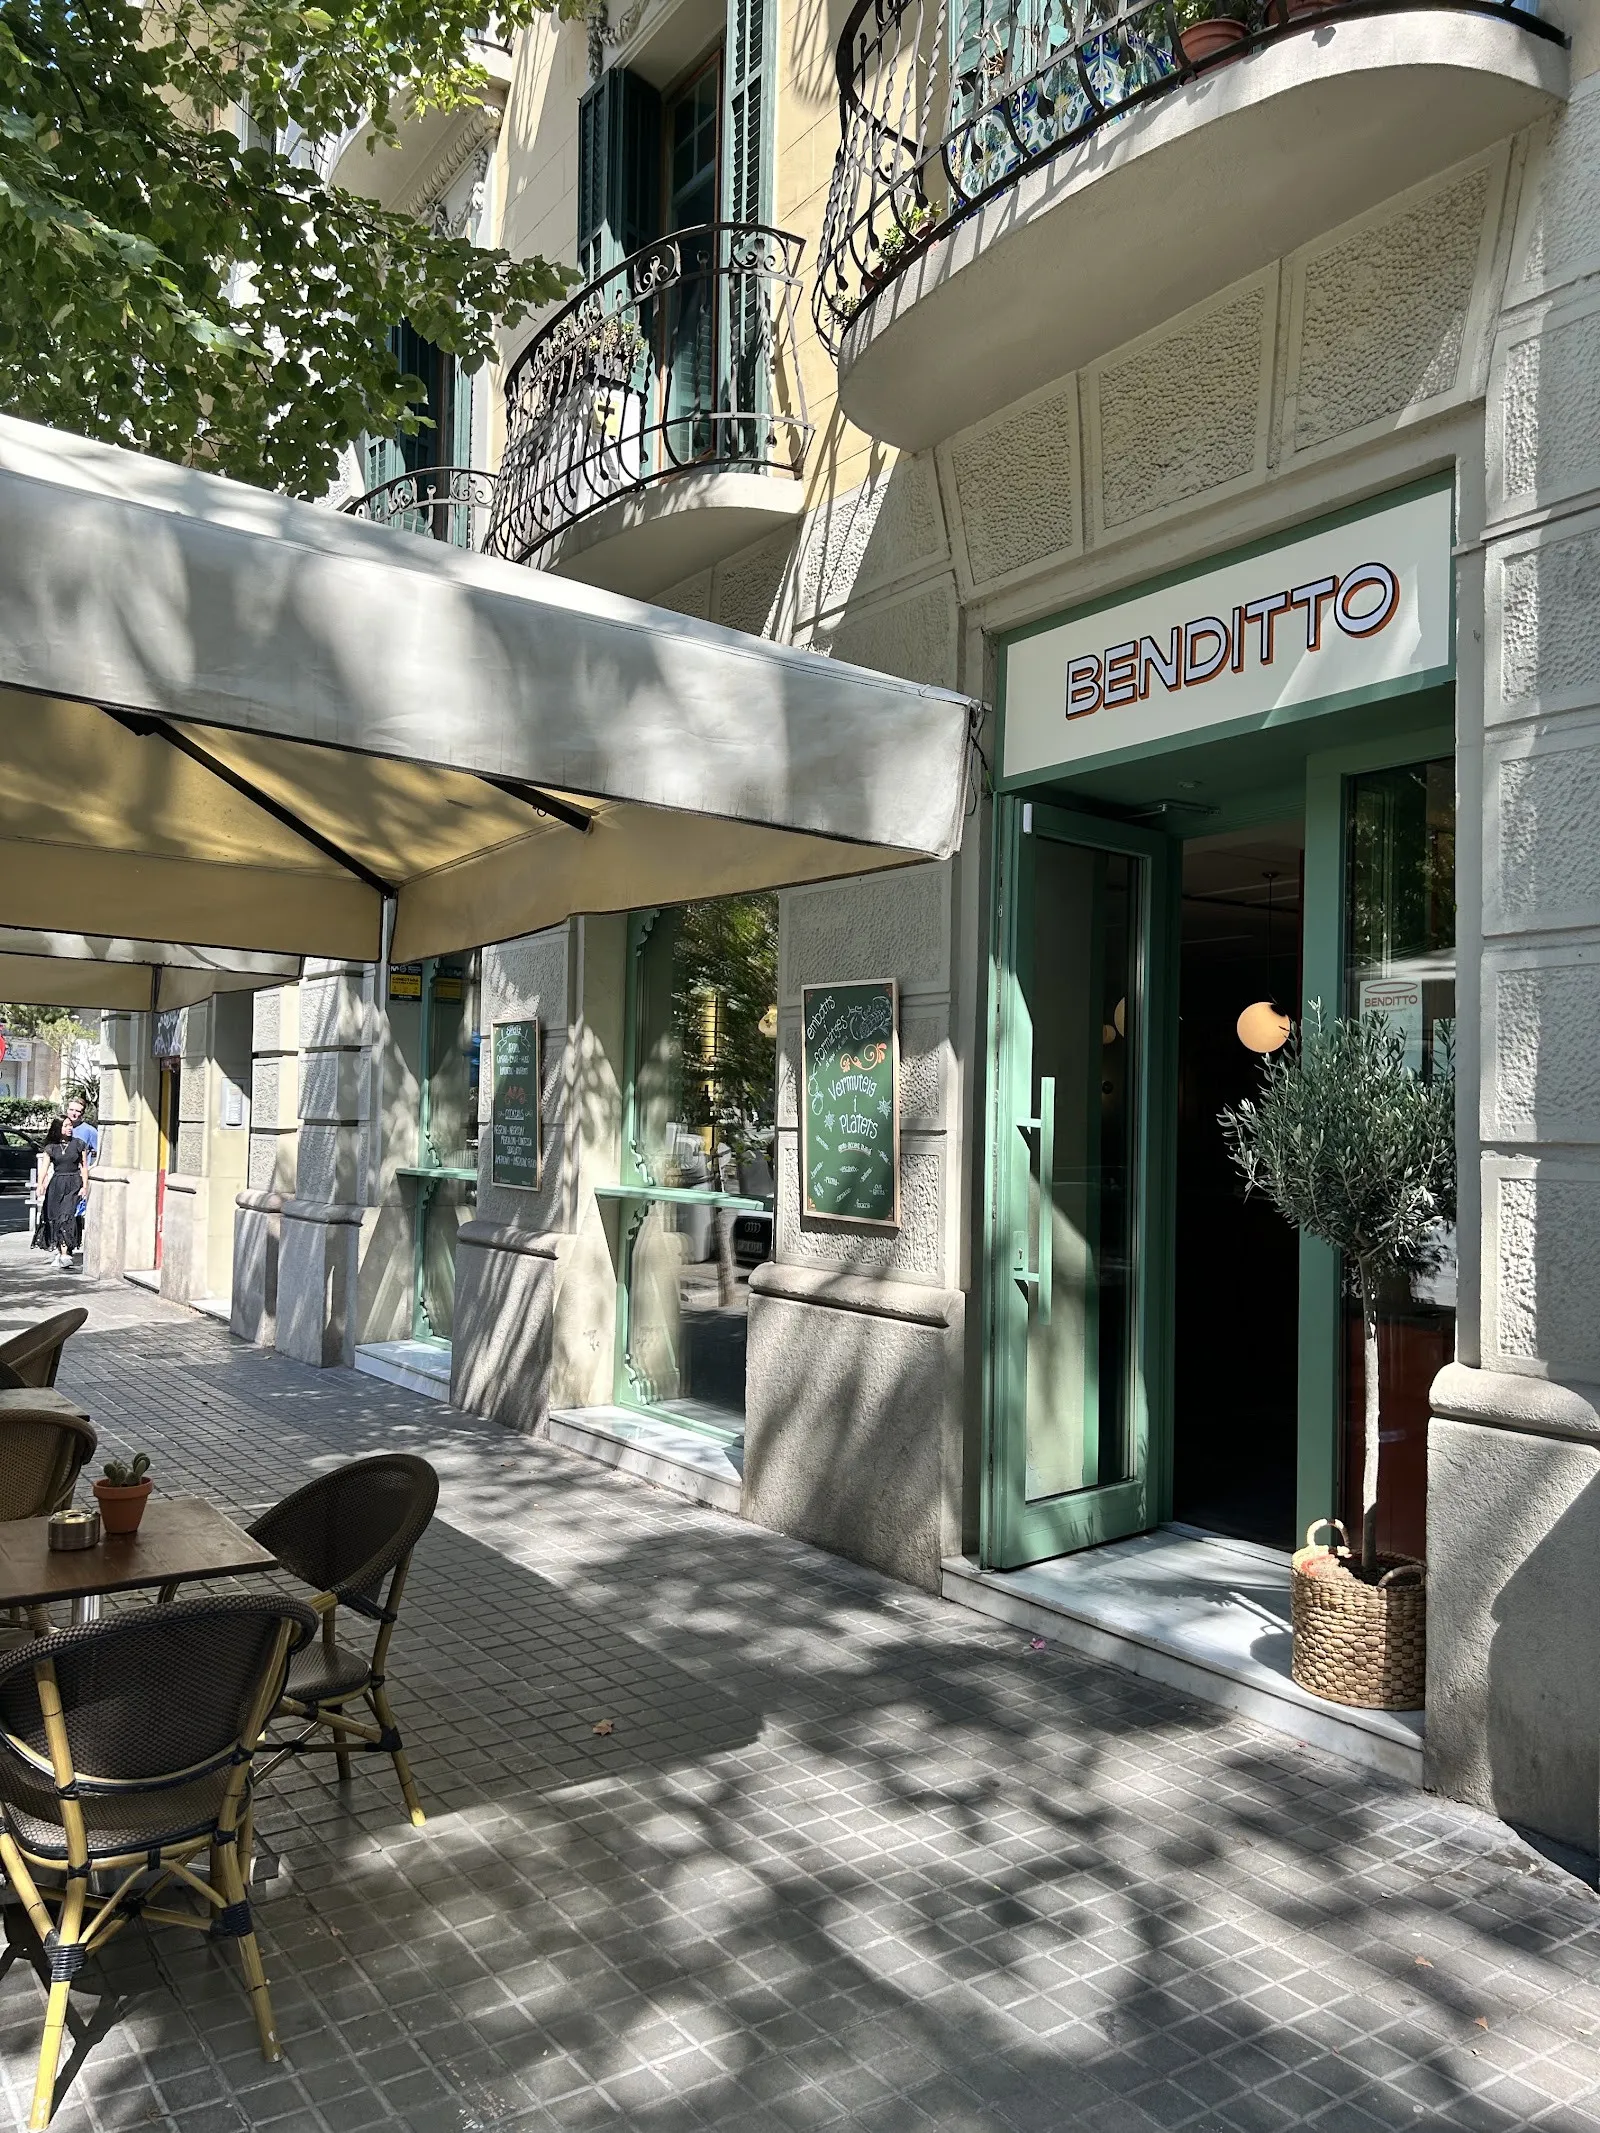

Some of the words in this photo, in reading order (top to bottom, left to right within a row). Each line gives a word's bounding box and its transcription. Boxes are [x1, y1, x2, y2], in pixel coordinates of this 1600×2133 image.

[1065, 561, 1400, 721] BENDITTO
[1364, 995, 1418, 1008] BENDITTO
[814, 1015, 848, 1067] formatges
[828, 1074, 878, 1101] Vermuteig
[853, 1094, 857, 1113] i
